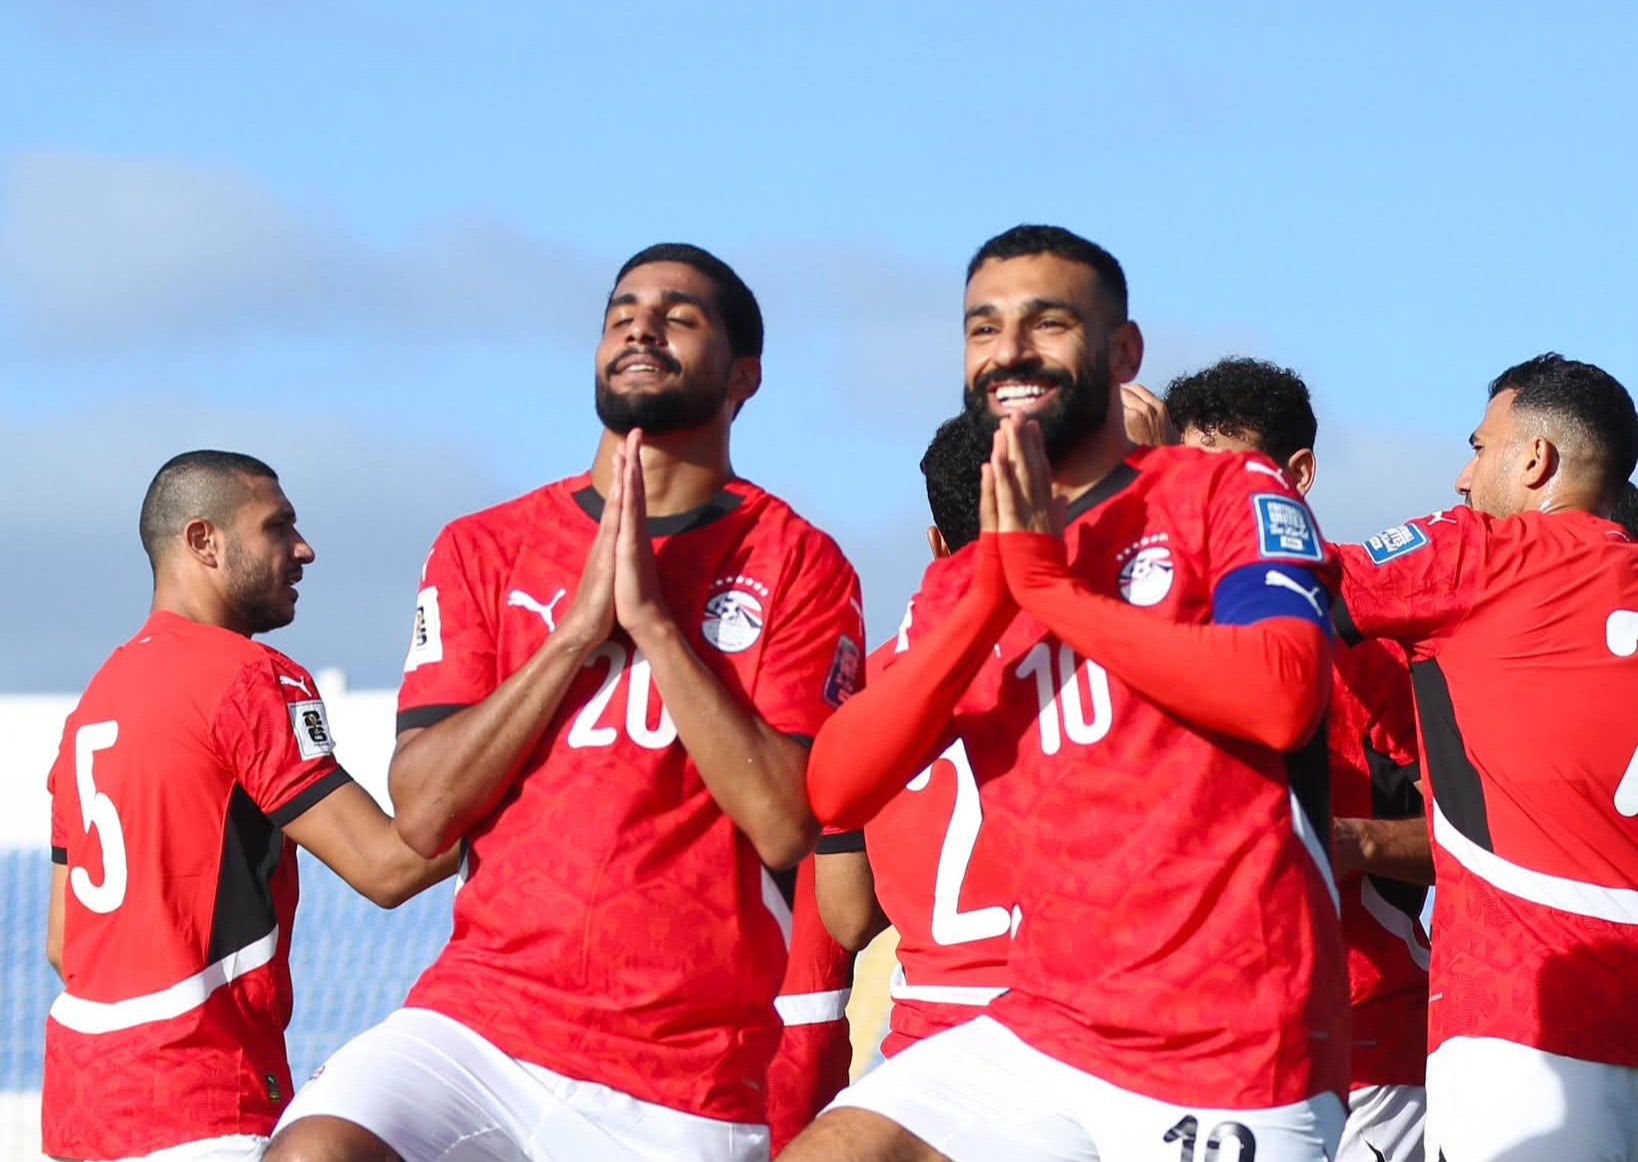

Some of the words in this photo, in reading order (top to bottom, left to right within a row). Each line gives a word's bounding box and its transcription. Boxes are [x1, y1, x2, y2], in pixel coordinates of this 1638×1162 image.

[567, 640, 678, 749] 20
[1015, 641, 1113, 756] 10
[70, 720, 128, 914] 5
[905, 737, 1023, 946] 2
